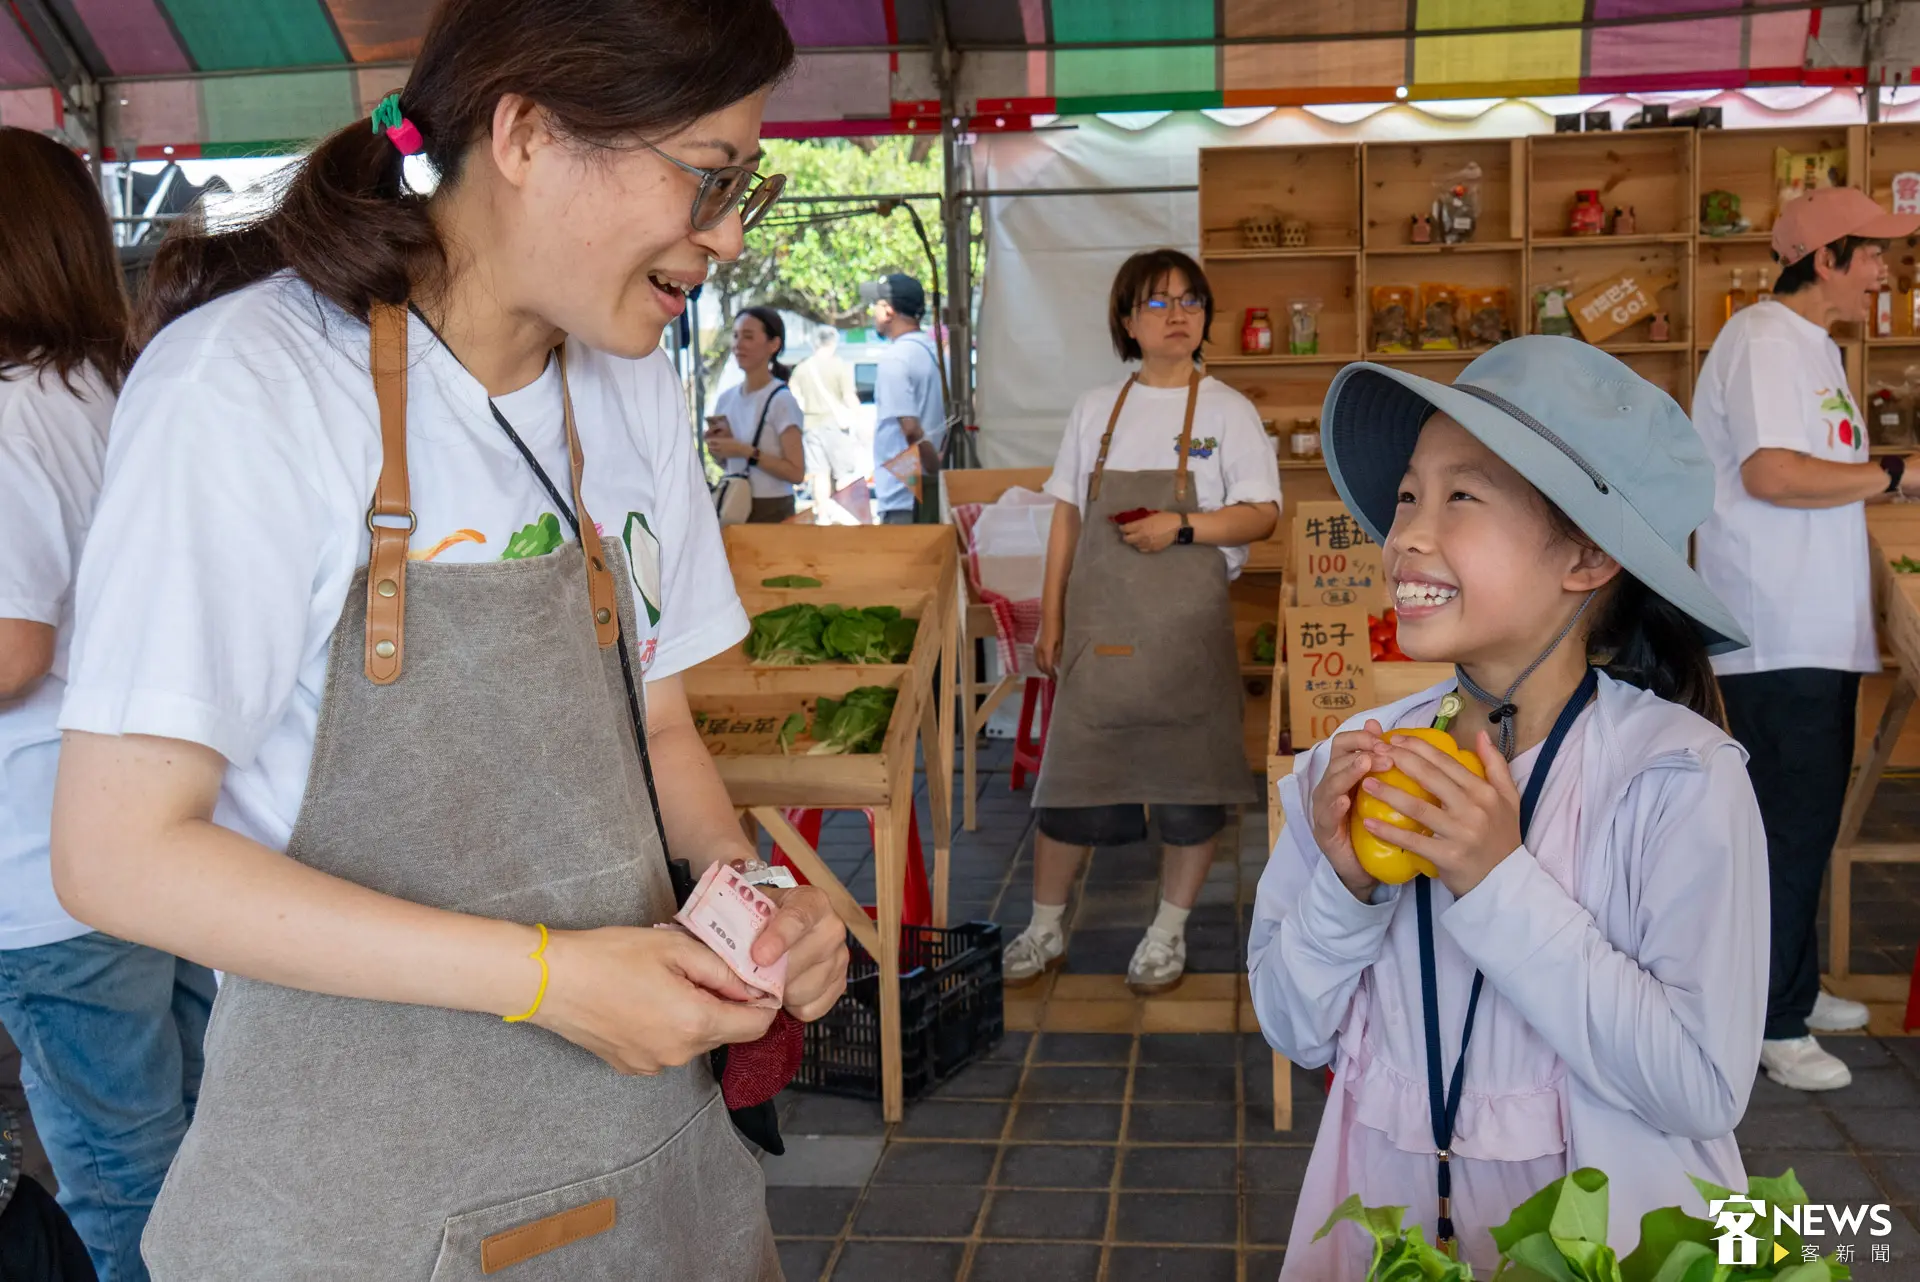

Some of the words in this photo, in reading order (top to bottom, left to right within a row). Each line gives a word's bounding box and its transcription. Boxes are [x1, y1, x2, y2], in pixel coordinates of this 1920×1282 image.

[1611, 289, 1648, 324] Go!
[1308, 554, 1347, 575] 100
[1300, 622, 1355, 649] 茄子
[1303, 652, 1344, 677] 70
[724, 873, 773, 918] 100
[708, 919, 738, 952] 100
